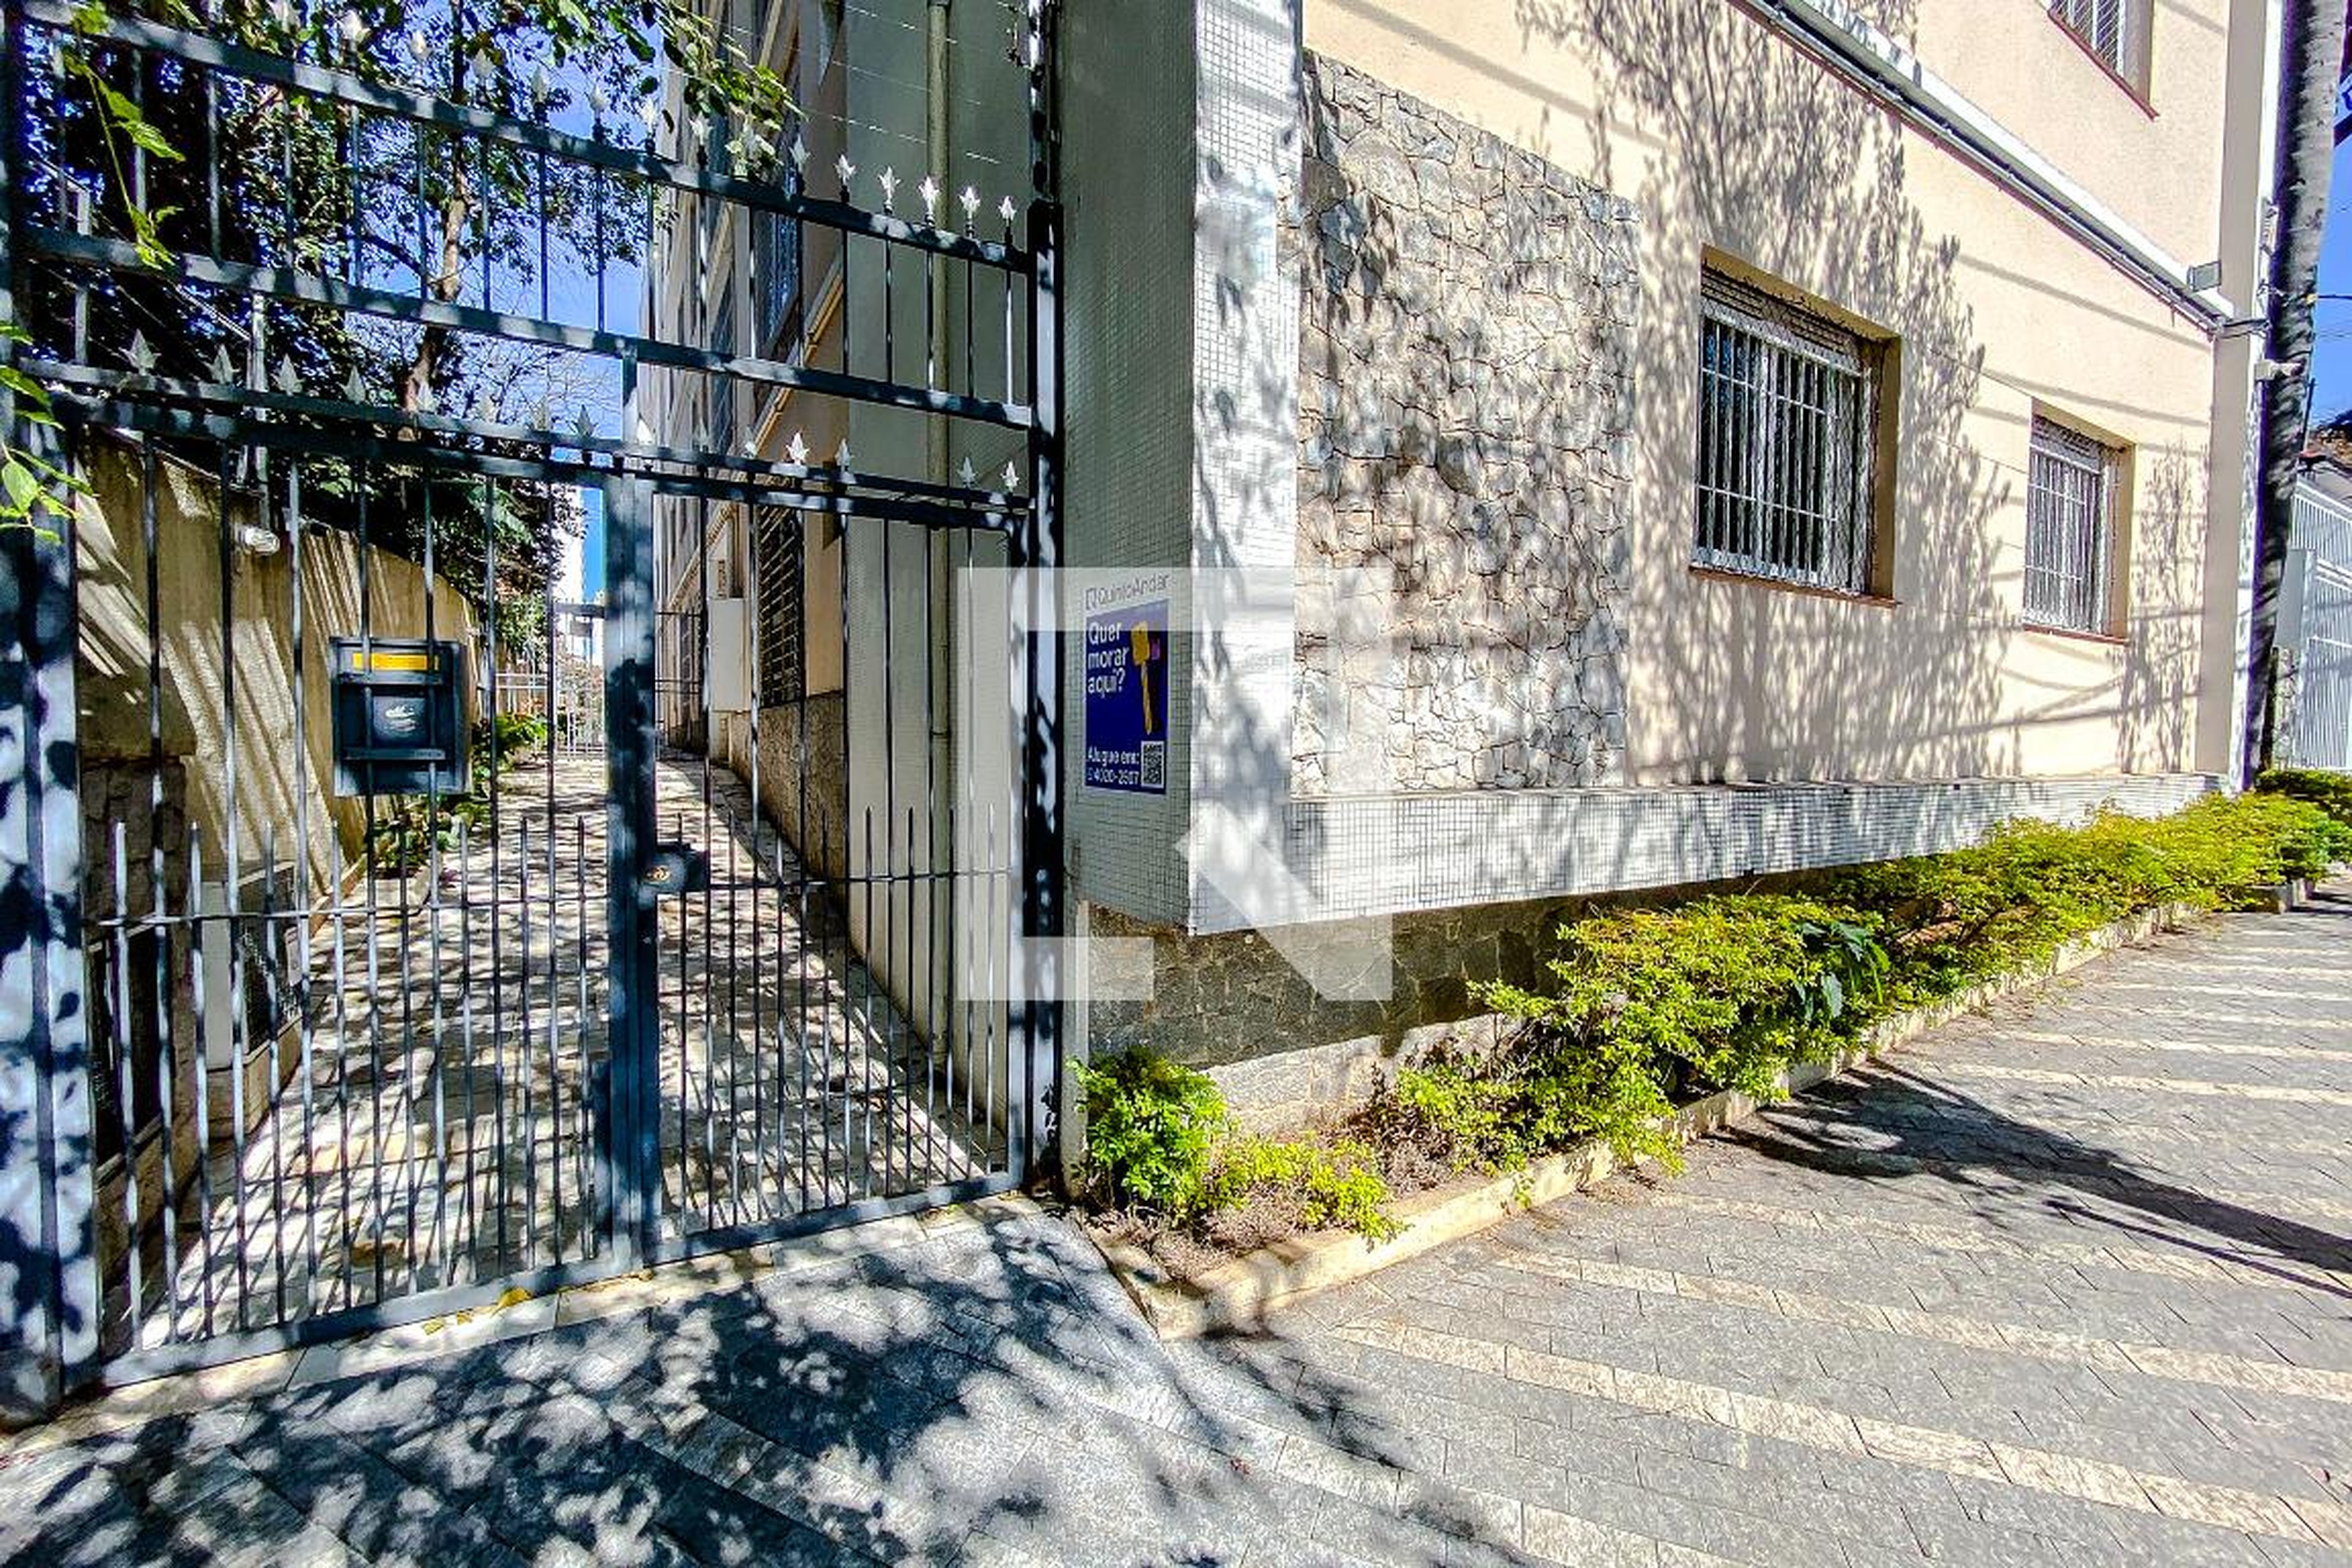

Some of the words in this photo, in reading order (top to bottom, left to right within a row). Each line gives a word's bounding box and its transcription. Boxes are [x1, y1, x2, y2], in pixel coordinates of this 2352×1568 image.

[1088, 622, 1122, 646] Quer
[1088, 646, 1129, 669] morar
[1088, 667, 1125, 699] aqui?
